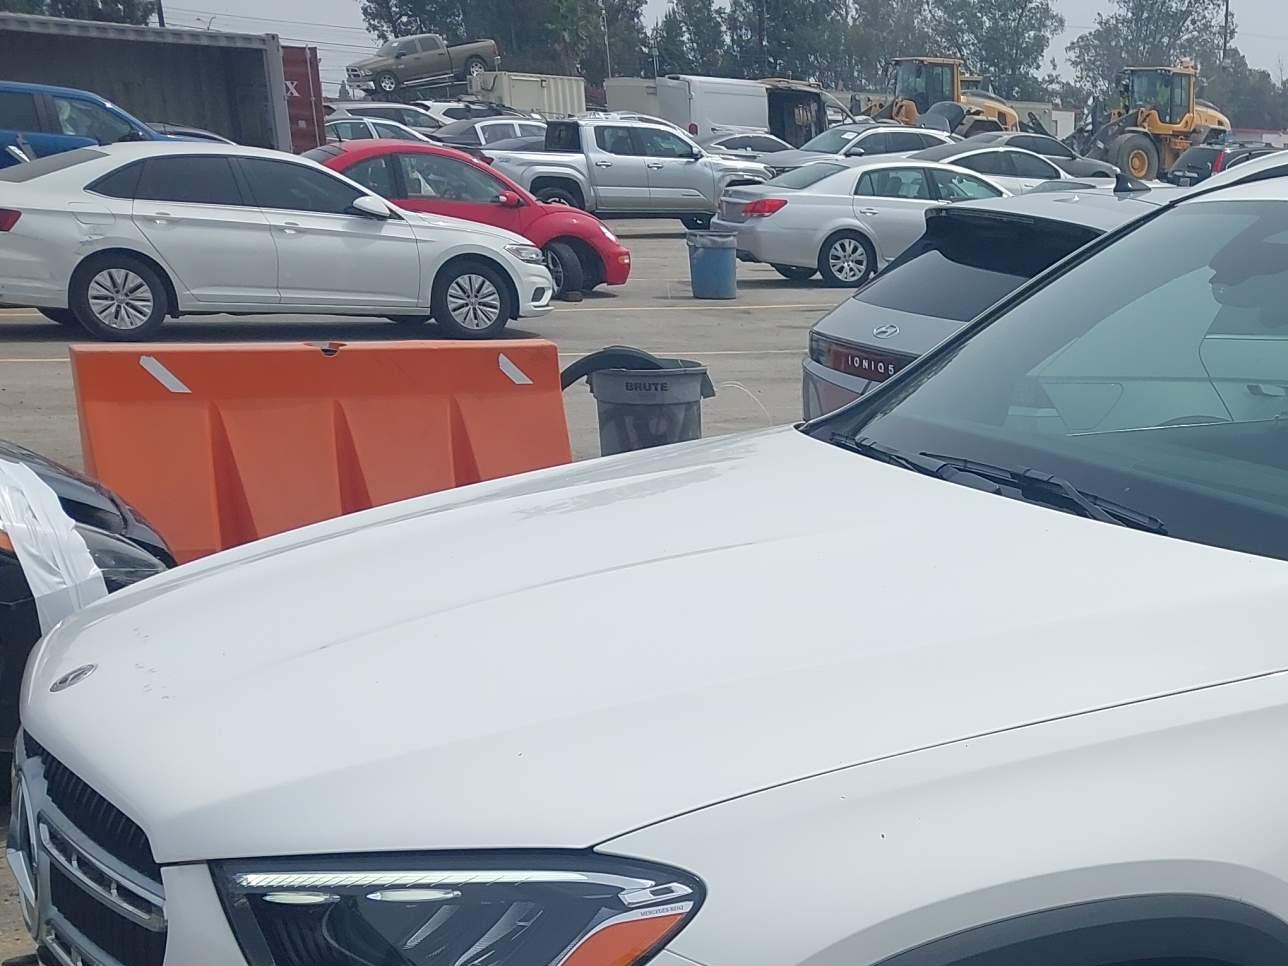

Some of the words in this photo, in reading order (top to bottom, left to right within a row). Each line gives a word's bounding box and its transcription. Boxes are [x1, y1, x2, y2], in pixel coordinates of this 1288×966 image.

[848, 354, 885, 373] IONIQ
[888, 364, 895, 375] 5
[624, 381, 669, 392] BRUTE
